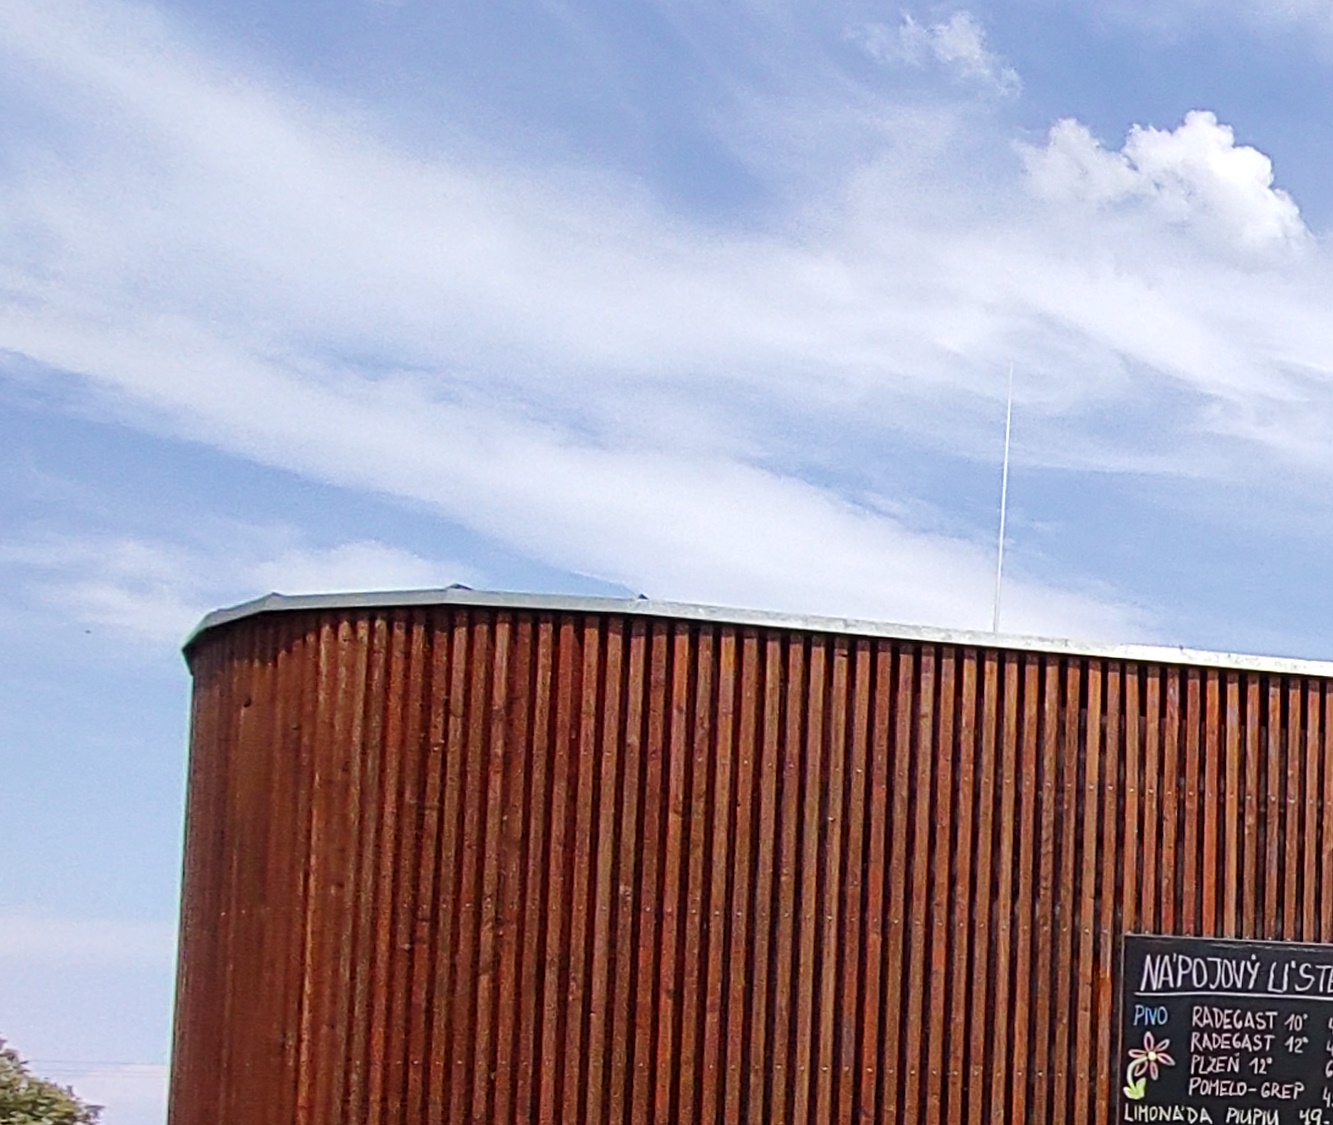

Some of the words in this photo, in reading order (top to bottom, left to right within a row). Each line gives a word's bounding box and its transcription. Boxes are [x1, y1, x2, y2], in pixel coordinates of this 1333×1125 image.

[1140, 953, 1260, 992] NÁPOJOVÝ
[1133, 1005, 1168, 1026] PIVO
[1192, 1005, 1278, 1030] RADEGAST
[1190, 1033, 1276, 1053] RADEGAST
[1190, 1053, 1240, 1075] PLZEŇ
[1249, 1058, 1273, 1076] 12°
[1124, 1102, 1213, 1125] LIMONÁDA
